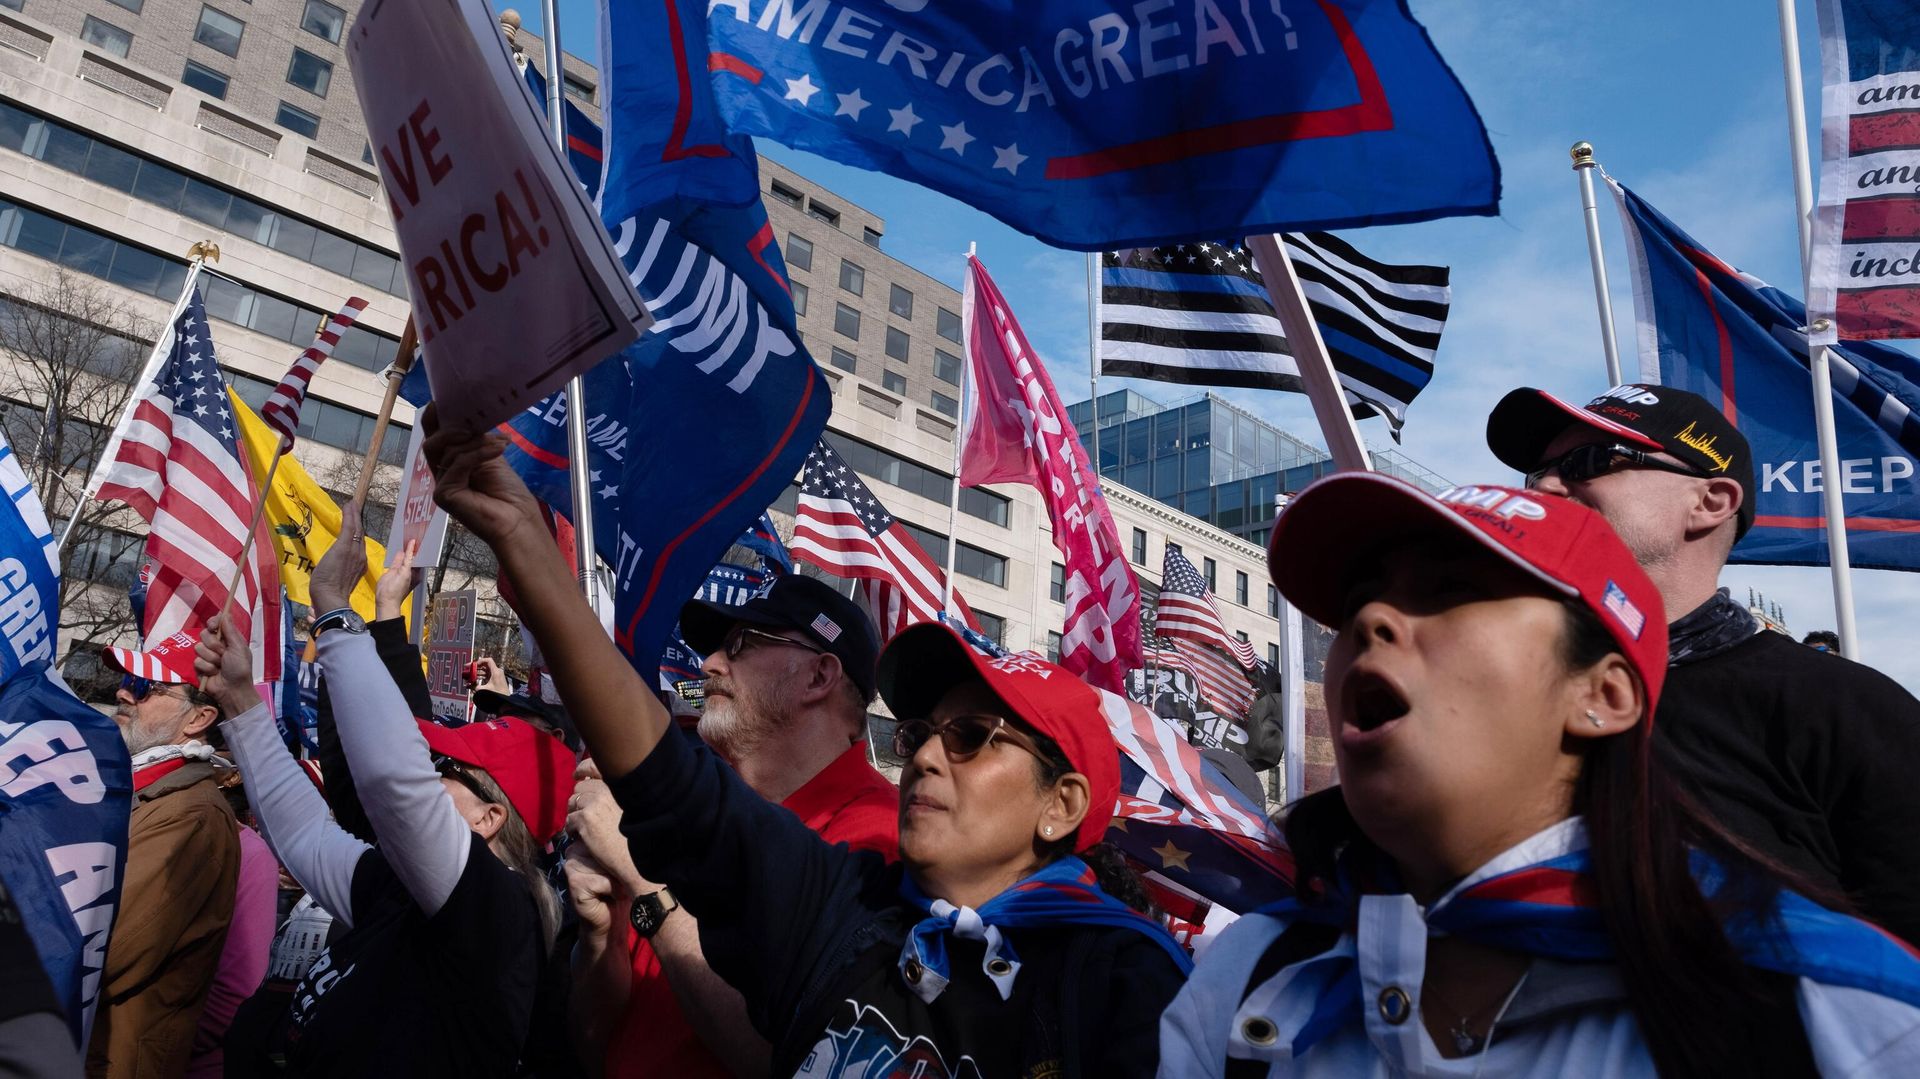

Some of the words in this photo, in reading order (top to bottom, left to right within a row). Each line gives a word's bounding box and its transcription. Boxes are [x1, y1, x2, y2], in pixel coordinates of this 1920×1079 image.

[387, 97, 453, 222] VE
[422, 168, 549, 344] RICA!
[1762, 456, 1914, 494] KEEP
[404, 493, 433, 524] STEAL
[432, 596, 468, 643] STOP
